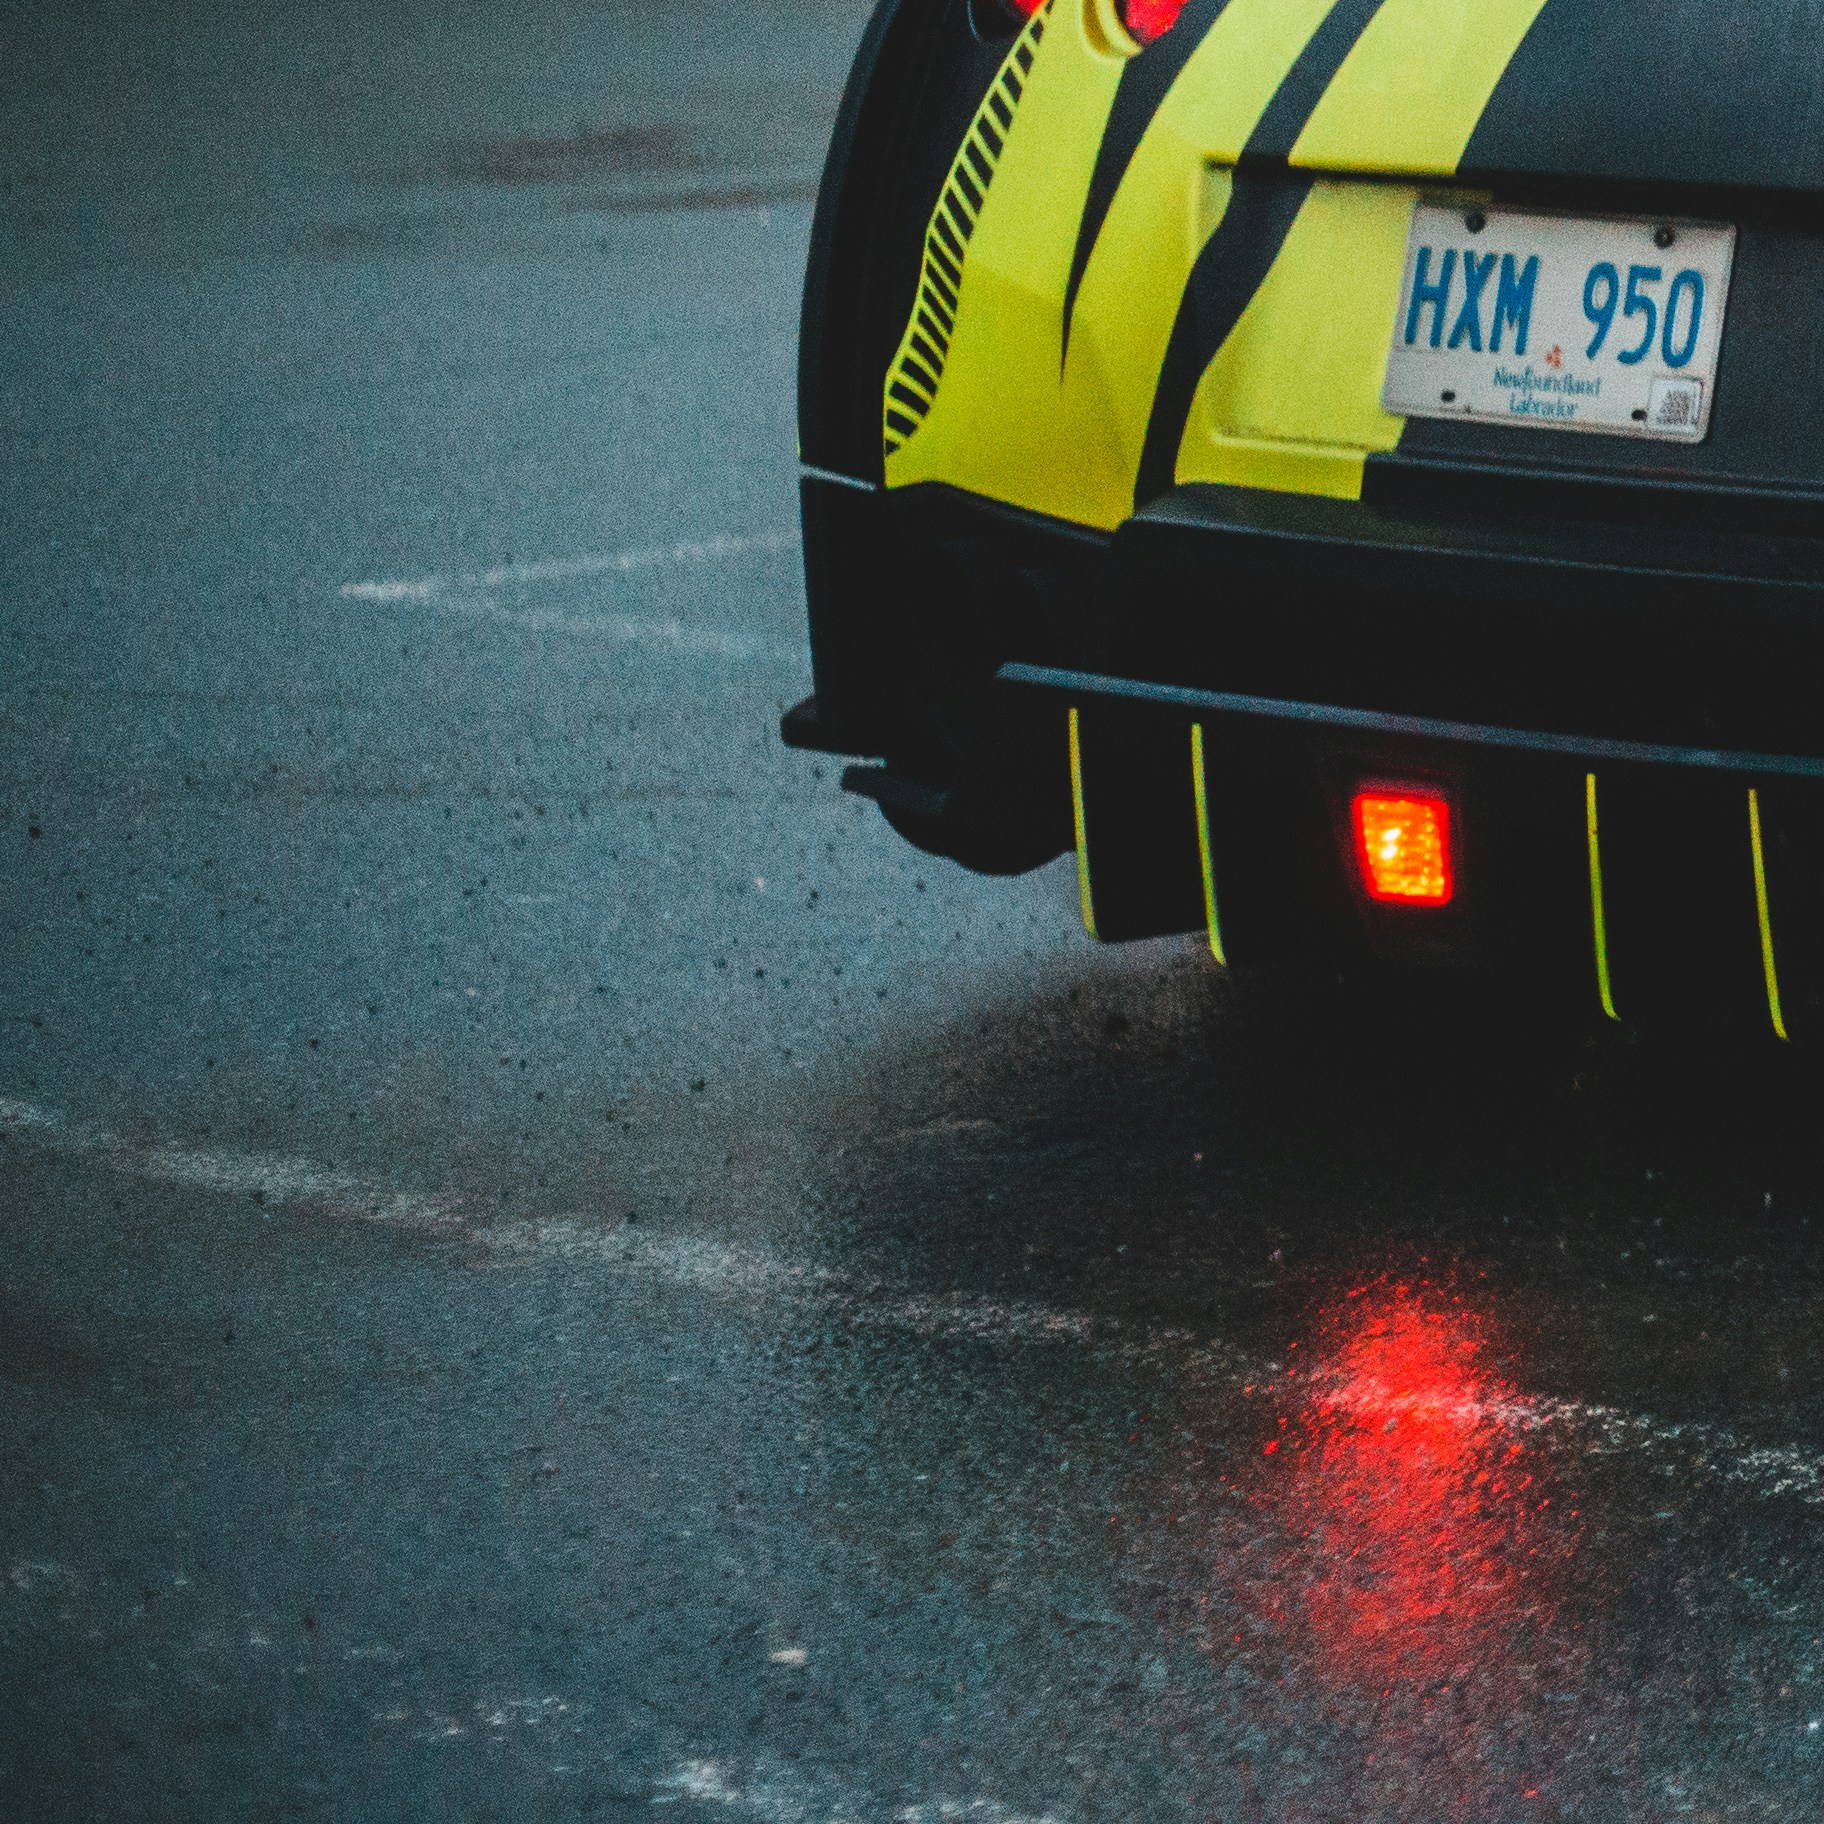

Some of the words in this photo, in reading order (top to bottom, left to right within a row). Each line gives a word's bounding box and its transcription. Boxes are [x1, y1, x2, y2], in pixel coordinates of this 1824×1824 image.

[1404, 245, 1540, 356] HXM
[1582, 261, 1705, 369] 950
[1494, 366, 1601, 397] Newfoundland
[1509, 392, 1579, 418] Labrador
